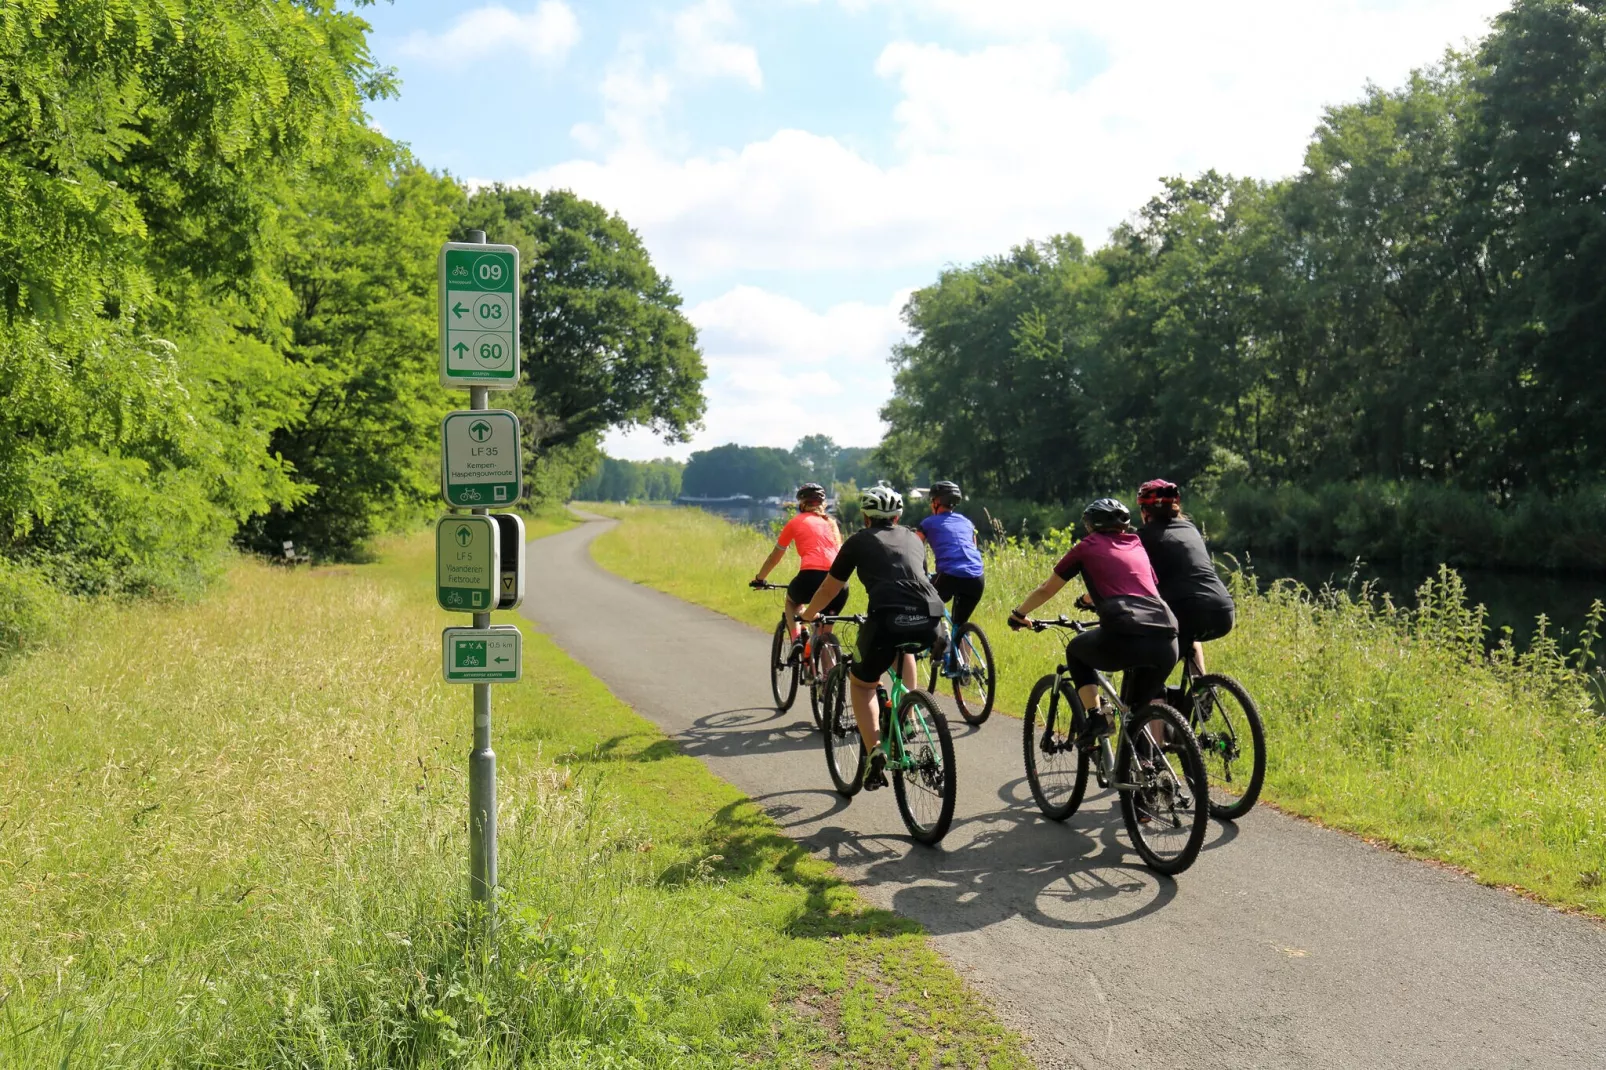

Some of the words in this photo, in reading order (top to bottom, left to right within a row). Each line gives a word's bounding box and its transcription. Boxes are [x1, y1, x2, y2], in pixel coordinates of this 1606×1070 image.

[479, 264, 502, 280] 09
[479, 303, 502, 319] 03
[479, 343, 502, 359] 60
[471, 447, 484, 456] LF
[486, 447, 498, 456] 35
[451, 470, 513, 478] Haspengouwroute
[456, 552, 465, 560] LF
[467, 552, 472, 560] 5
[446, 564, 483, 573] Vlaanderen
[448, 575, 480, 584] Fietsroute
